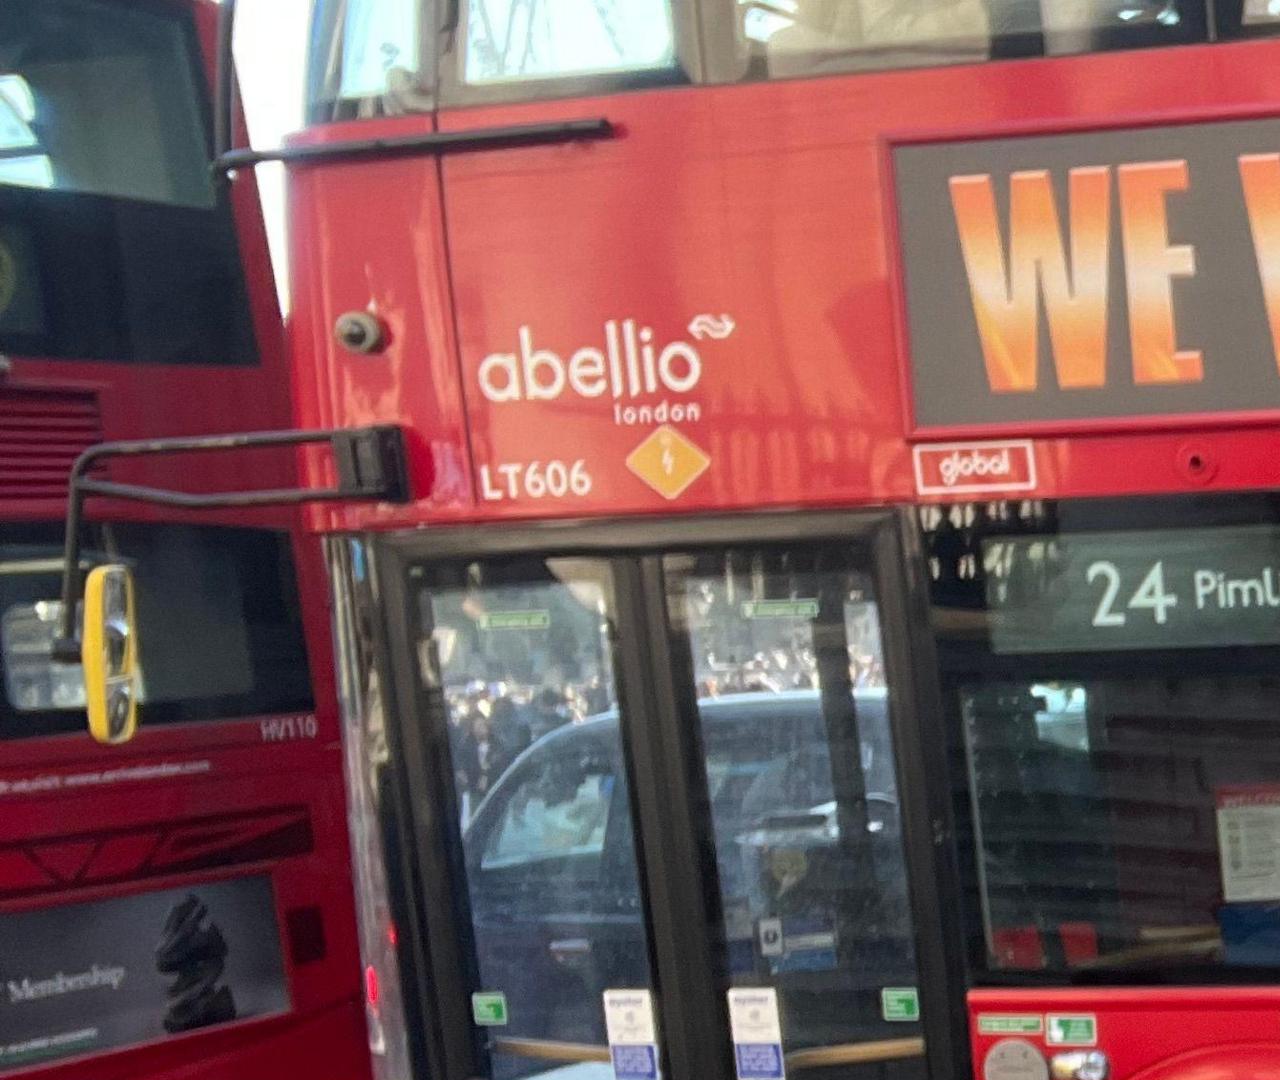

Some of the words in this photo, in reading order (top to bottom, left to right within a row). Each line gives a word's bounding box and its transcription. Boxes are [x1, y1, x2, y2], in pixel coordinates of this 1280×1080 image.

[948, 159, 1204, 394] WE
[478, 319, 701, 402] abellio
[613, 400, 701, 425] london
[480, 459, 593, 500] LT606
[939, 449, 1010, 487] global
[1087, 560, 1178, 627] 24
[7, 964, 125, 1002] Membership
